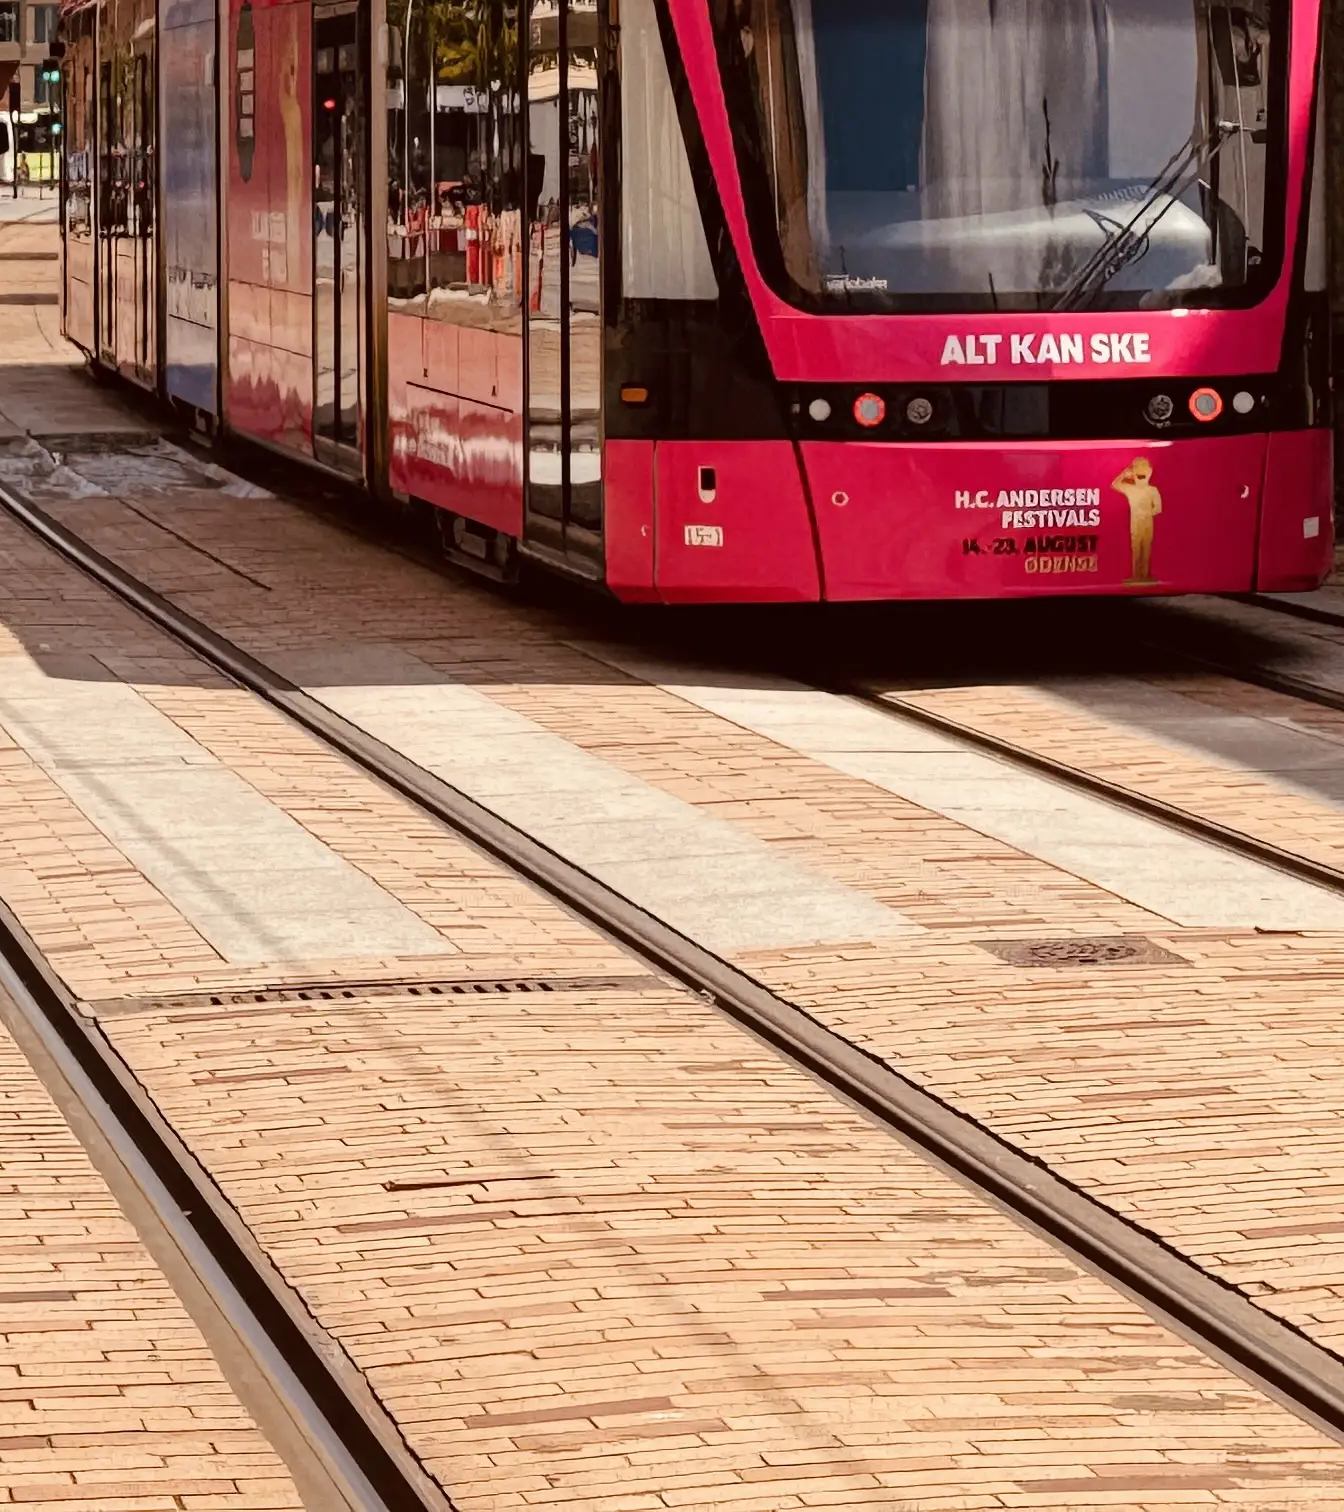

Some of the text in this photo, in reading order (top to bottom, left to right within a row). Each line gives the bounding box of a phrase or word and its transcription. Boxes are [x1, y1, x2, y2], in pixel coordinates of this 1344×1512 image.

[940, 334, 1002, 365] ALT
[1090, 332, 1151, 364] SKE
[955, 488, 1100, 509] H.C. ANDERSEN
[1001, 509, 1100, 529] FESTIVALS
[1023, 535, 1098, 554] AUGUST
[1024, 555, 1098, 574] ODENSE
